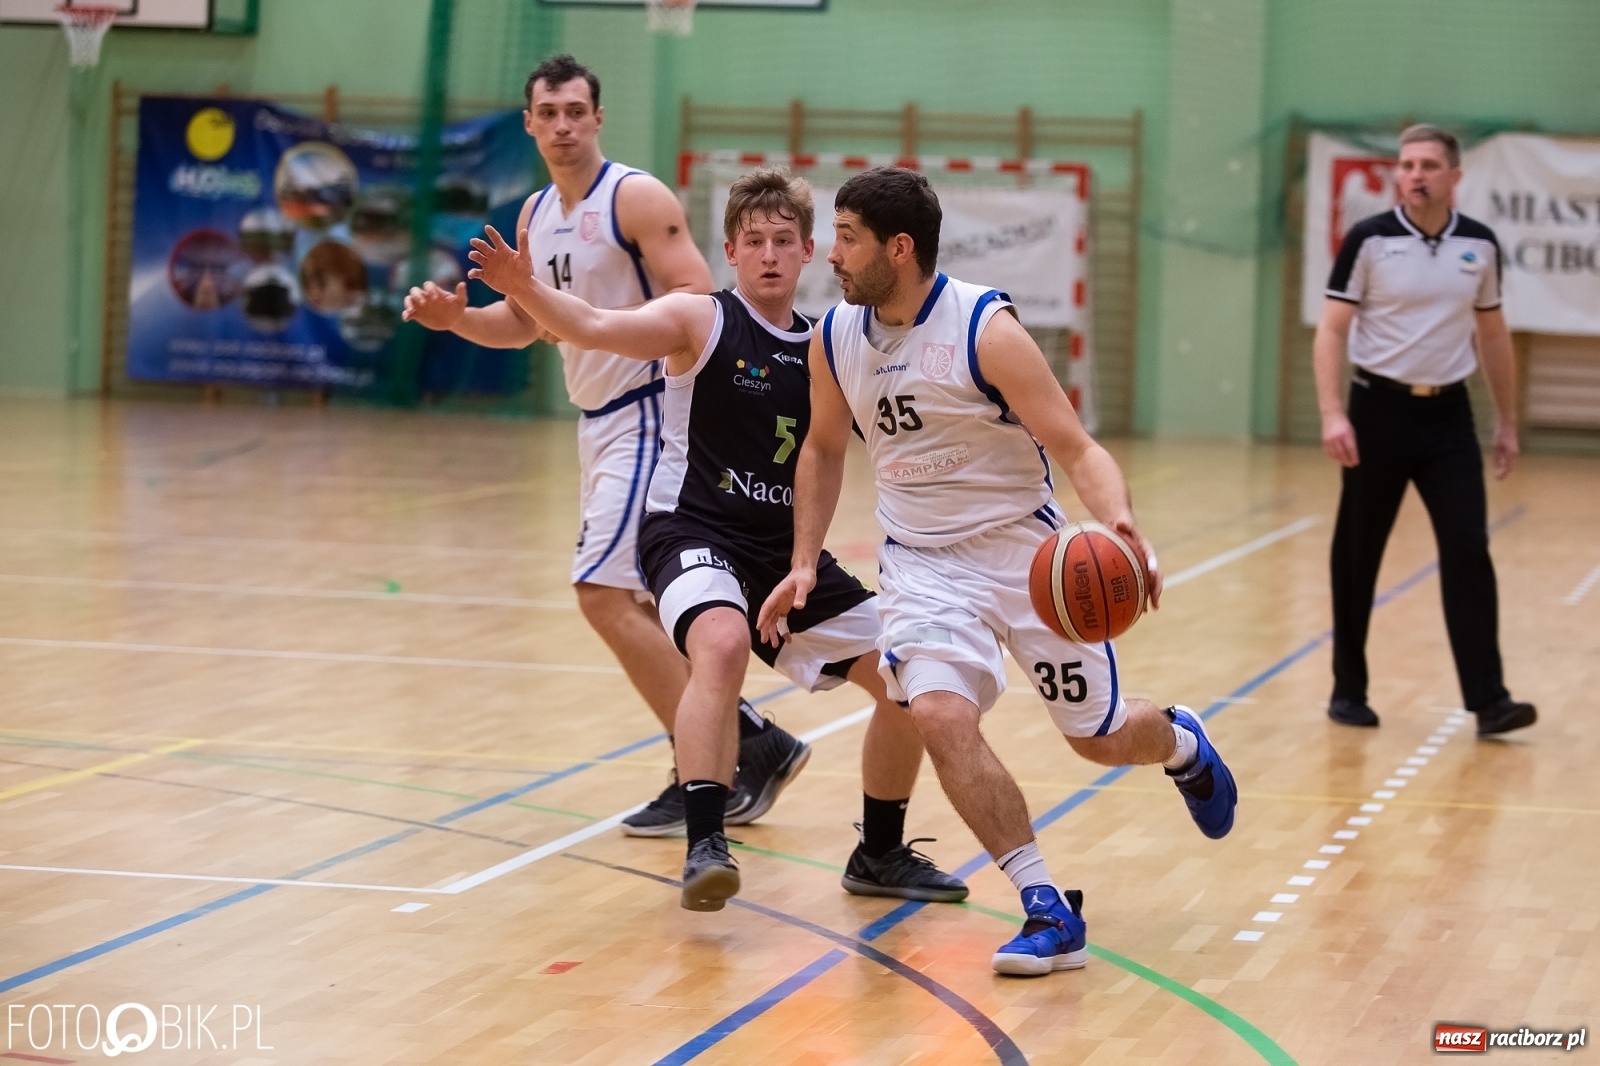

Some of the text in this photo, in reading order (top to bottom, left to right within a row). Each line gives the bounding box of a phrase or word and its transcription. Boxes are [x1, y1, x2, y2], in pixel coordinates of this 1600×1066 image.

[547, 253, 572, 290] 14
[733, 374, 772, 392] Cieszyn
[876, 394, 924, 436] 35
[773, 415, 797, 464] 5
[725, 467, 794, 506] Naco
[893, 457, 957, 479] KAMPKA
[1073, 560, 1099, 630] molten
[1110, 575, 1126, 604] FIBA
[1033, 660, 1088, 703] 35
